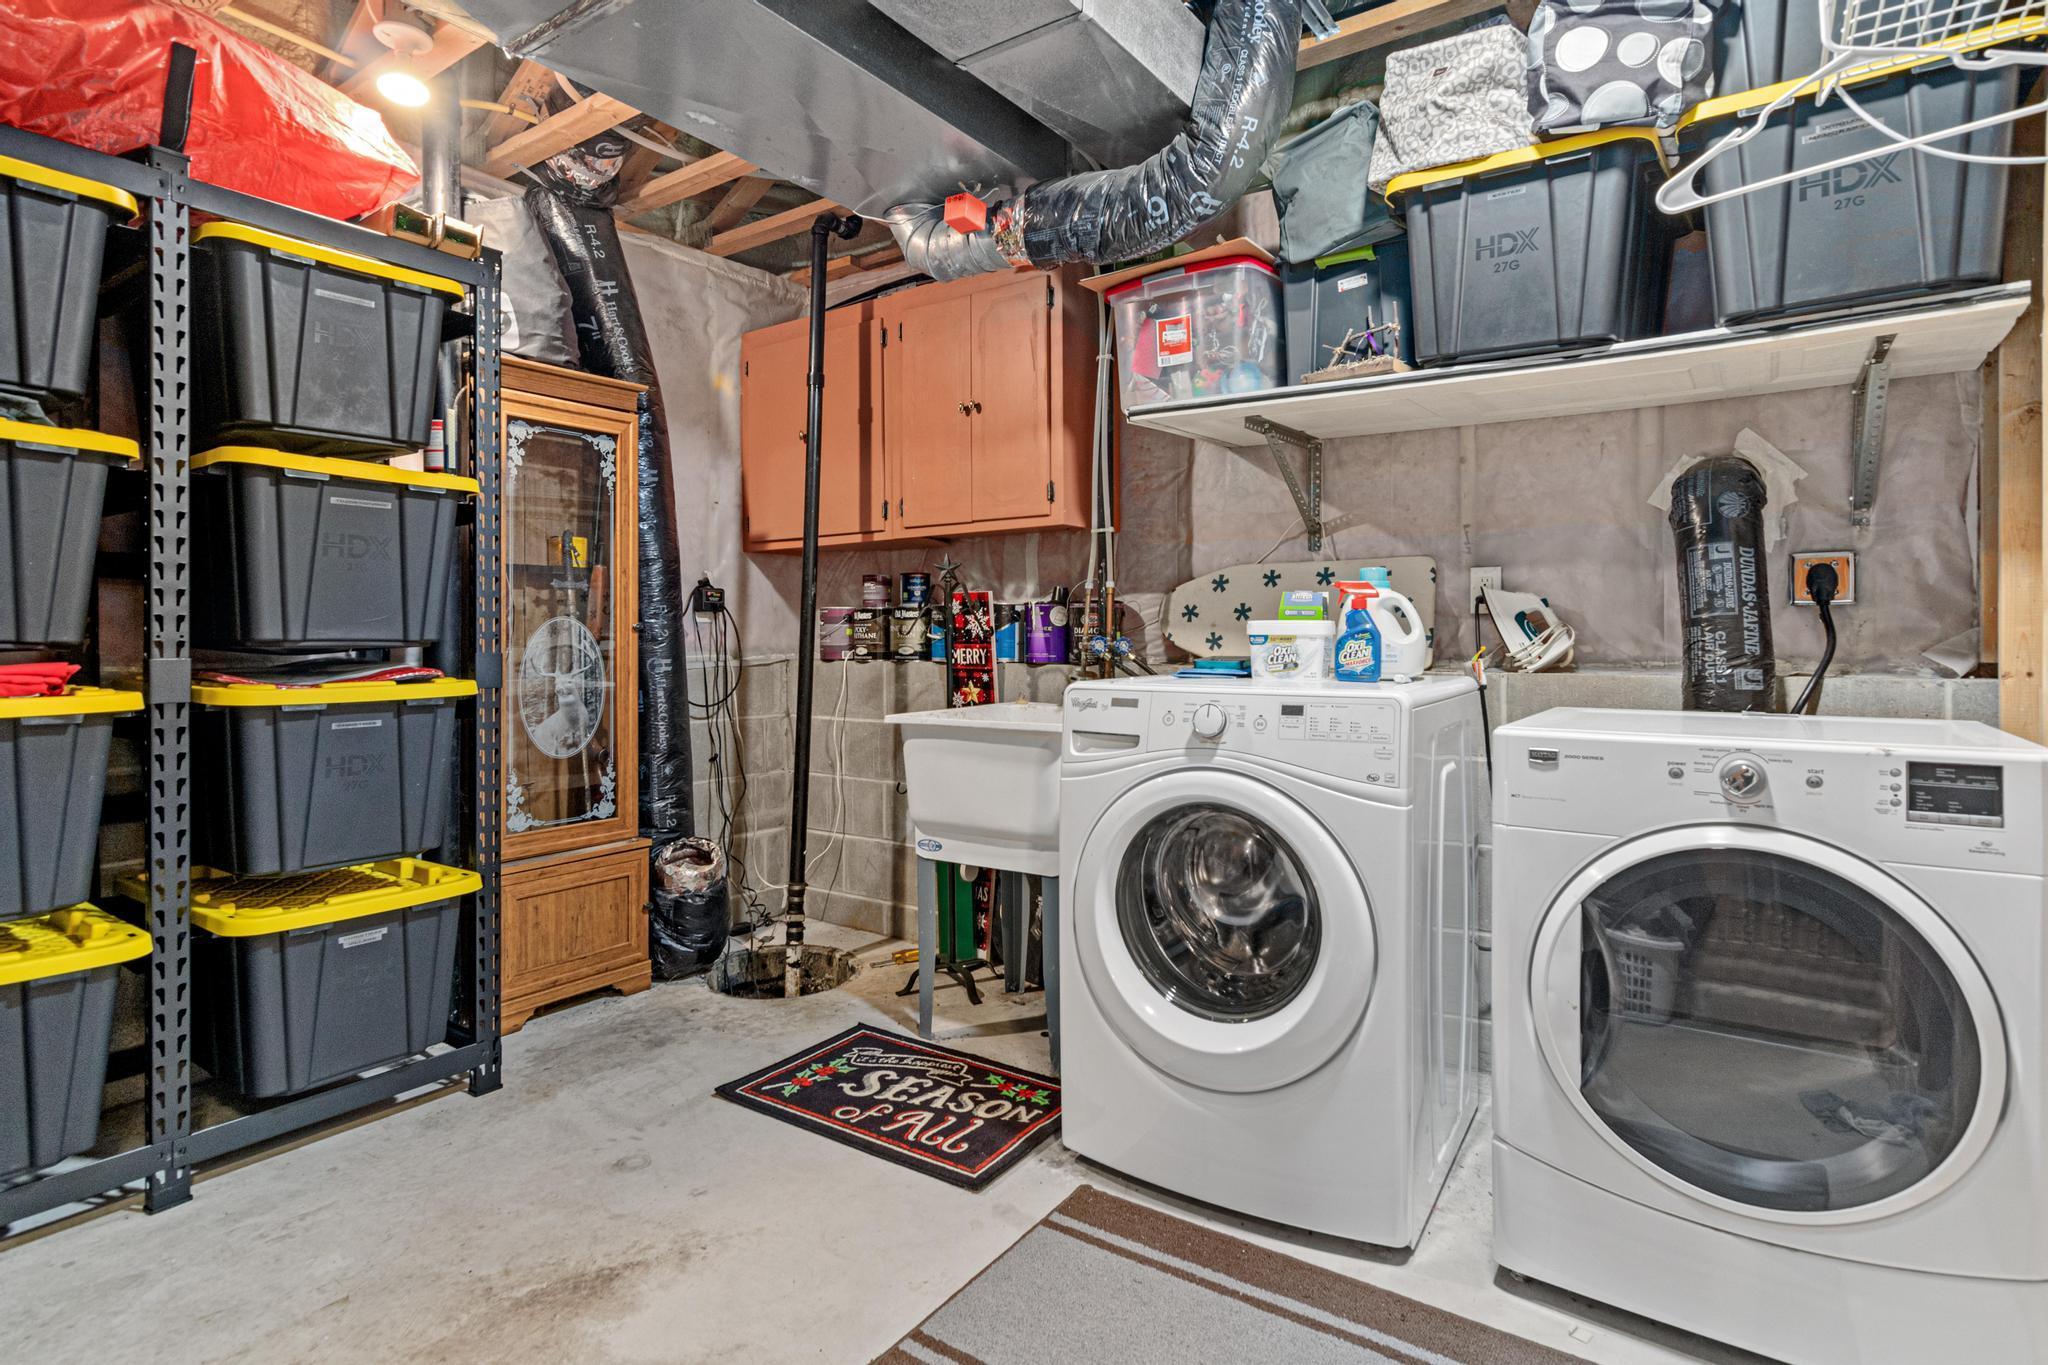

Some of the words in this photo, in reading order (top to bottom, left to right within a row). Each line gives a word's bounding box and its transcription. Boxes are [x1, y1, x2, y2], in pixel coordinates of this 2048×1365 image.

[1229, 115, 1259, 169] R-4.2
[1798, 149, 1903, 202] HDX
[1834, 195, 1865, 210] 27G
[584, 224, 606, 259] R-4.2
[1475, 226, 1540, 262] HDX
[1493, 259, 1521, 273] 27G
[577, 315, 601, 340] 7"
[1274, 646, 1292, 656] OXI
[1347, 641, 1366, 652] OXI
[1704, 632, 1715, 651] AIR
[952, 649, 987, 665] MERRY
[1268, 654, 1297, 665] CLEAN
[1342, 649, 1371, 660] CLEAN
[1715, 631, 1727, 674] CLASS
[838, 1070, 1043, 1123] SEASON
[833, 1104, 893, 1124] of
